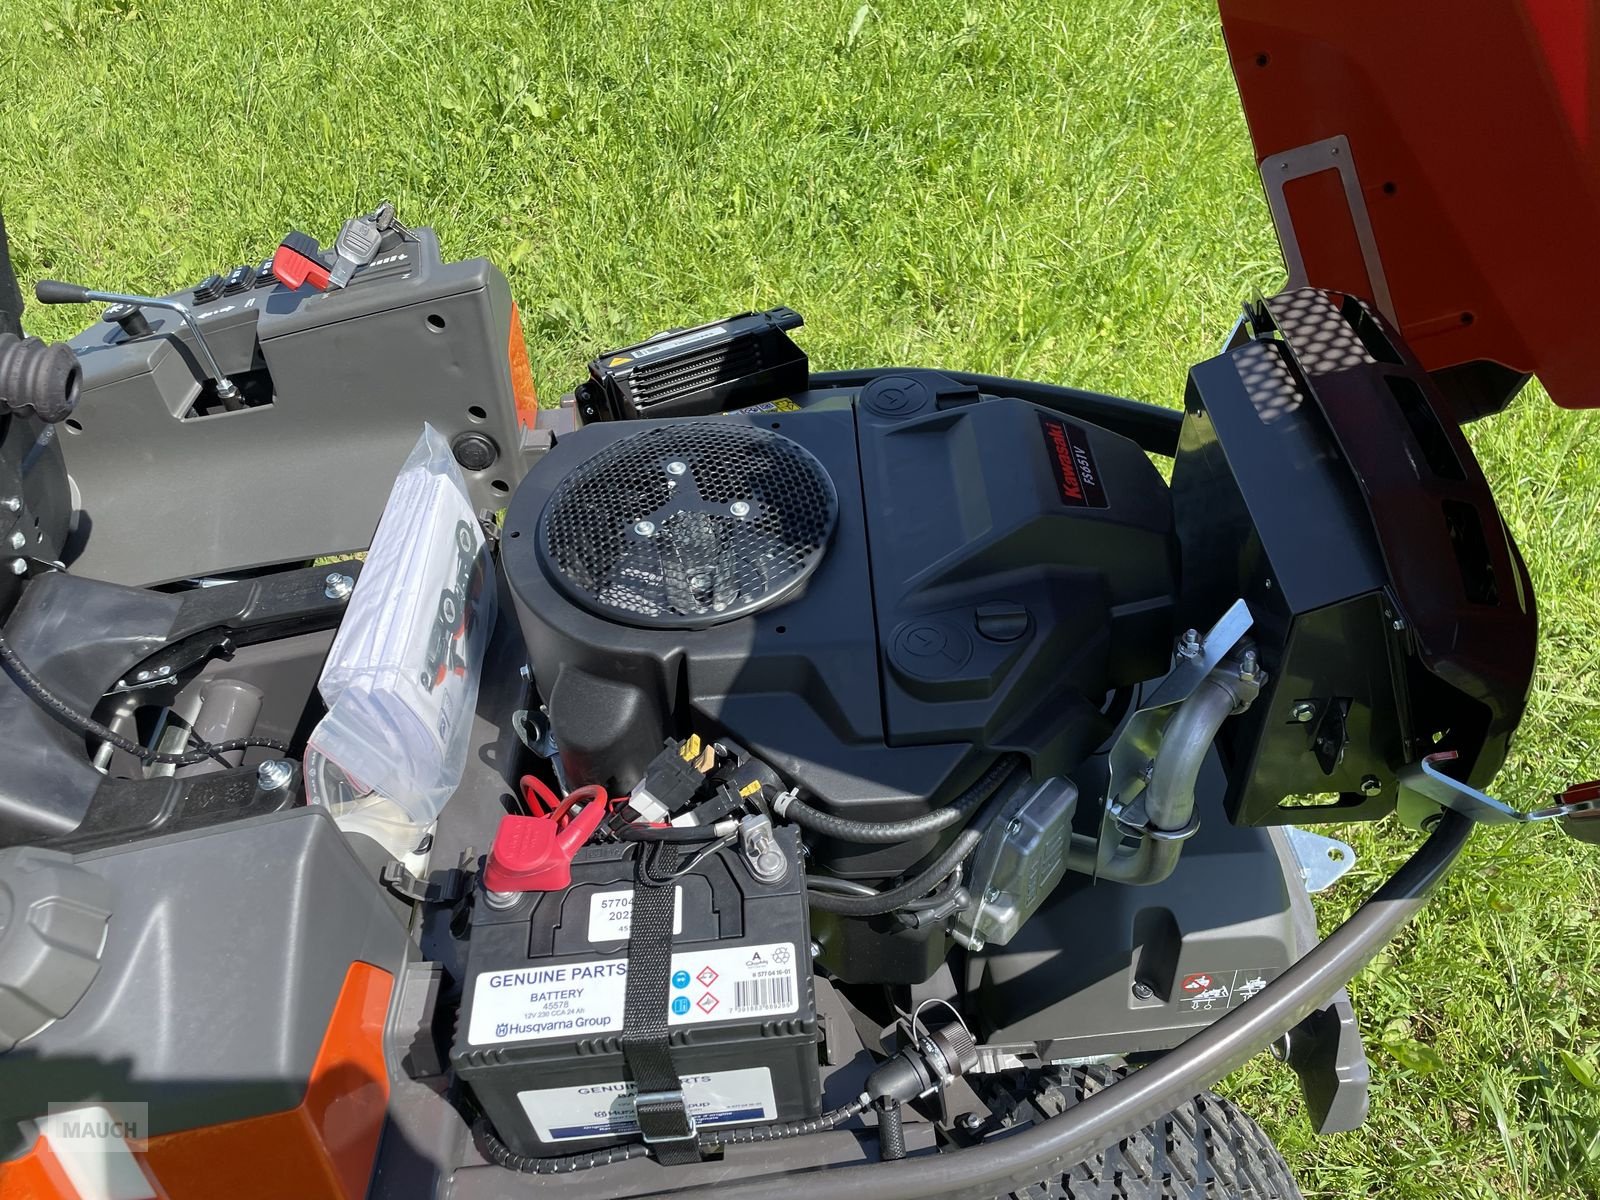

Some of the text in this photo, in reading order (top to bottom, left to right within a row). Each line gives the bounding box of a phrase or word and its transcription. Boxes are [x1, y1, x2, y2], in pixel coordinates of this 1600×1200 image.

[1045, 422, 1082, 500] Kawasaki
[1073, 445, 1095, 486] FS651V
[609, 911, 632, 921] 202
[489, 963, 627, 988] GENUINE PARTS
[530, 988, 584, 1002] BATTERY
[542, 1001, 569, 1010] 45578
[509, 1016, 611, 1035] Husqvarna Group
[680, 1076, 711, 1084] RTS
